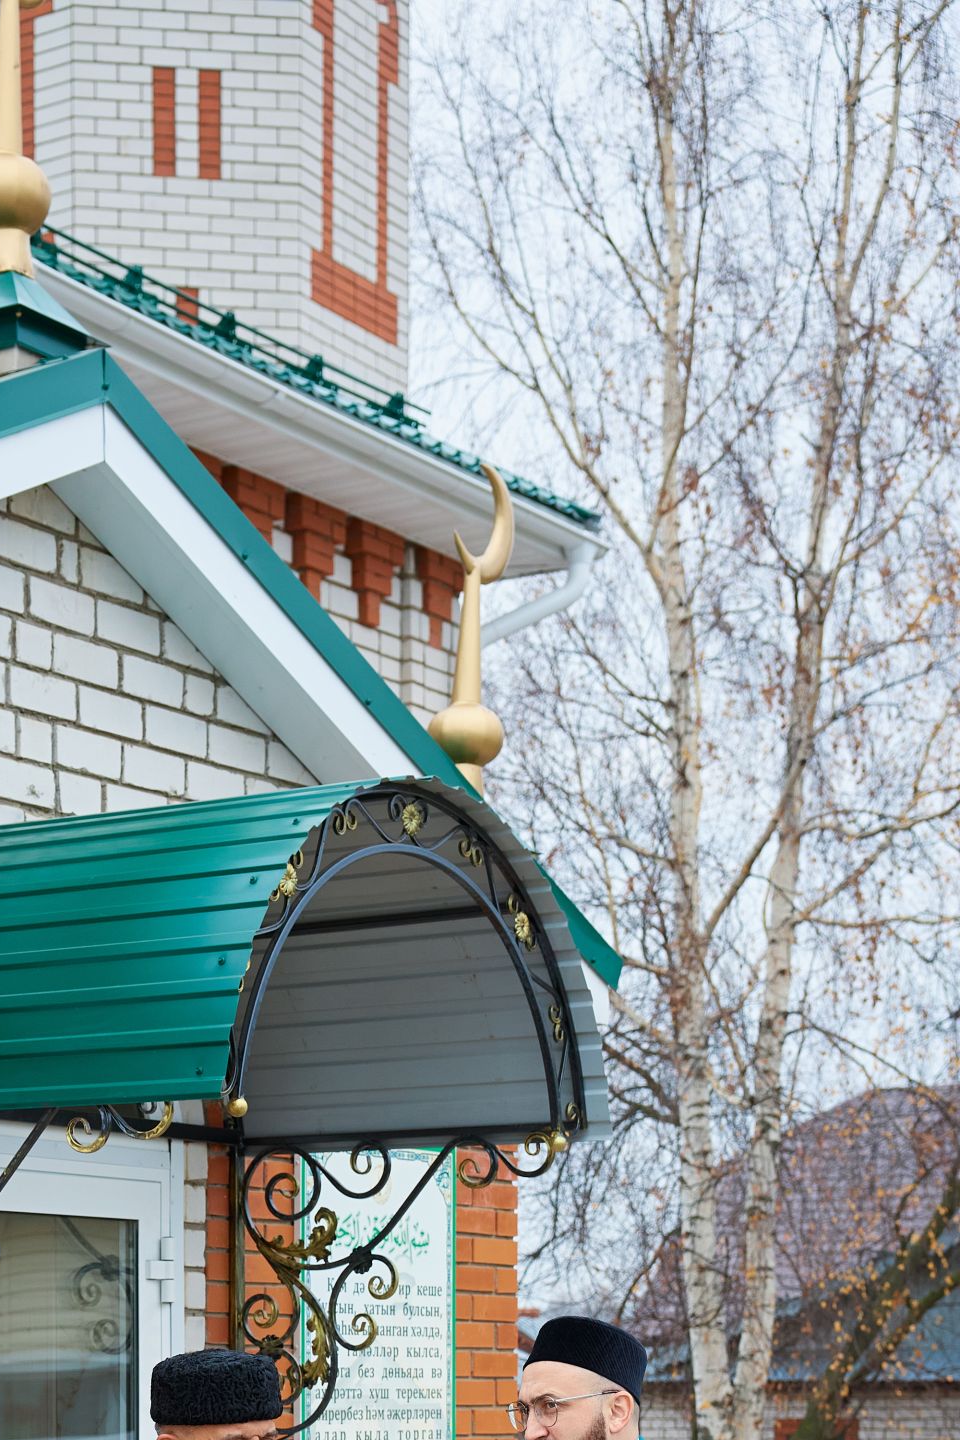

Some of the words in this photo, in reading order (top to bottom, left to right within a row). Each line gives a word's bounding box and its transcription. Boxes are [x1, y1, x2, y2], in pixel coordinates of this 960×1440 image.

[328, 1278, 347, 1293] Км
[353, 1285, 365, 1295] дә
[399, 1286, 411, 1298] ир
[417, 1286, 442, 1296] кеше
[364, 1304, 395, 1315] хатын
[403, 1302, 442, 1320] булсын,
[411, 1328, 442, 1340] хәлдә,
[406, 1347, 442, 1359] кылса,
[358, 1364, 375, 1378] без
[382, 1368, 424, 1379] дөньяда
[431, 1368, 442, 1376] вә
[316, 1388, 362, 1403] ахрәттә
[369, 1388, 388, 1402] хуш
[397, 1387, 442, 1402] тереклек
[318, 1407, 363, 1424] ирербез
[366, 1406, 384, 1420] һәм
